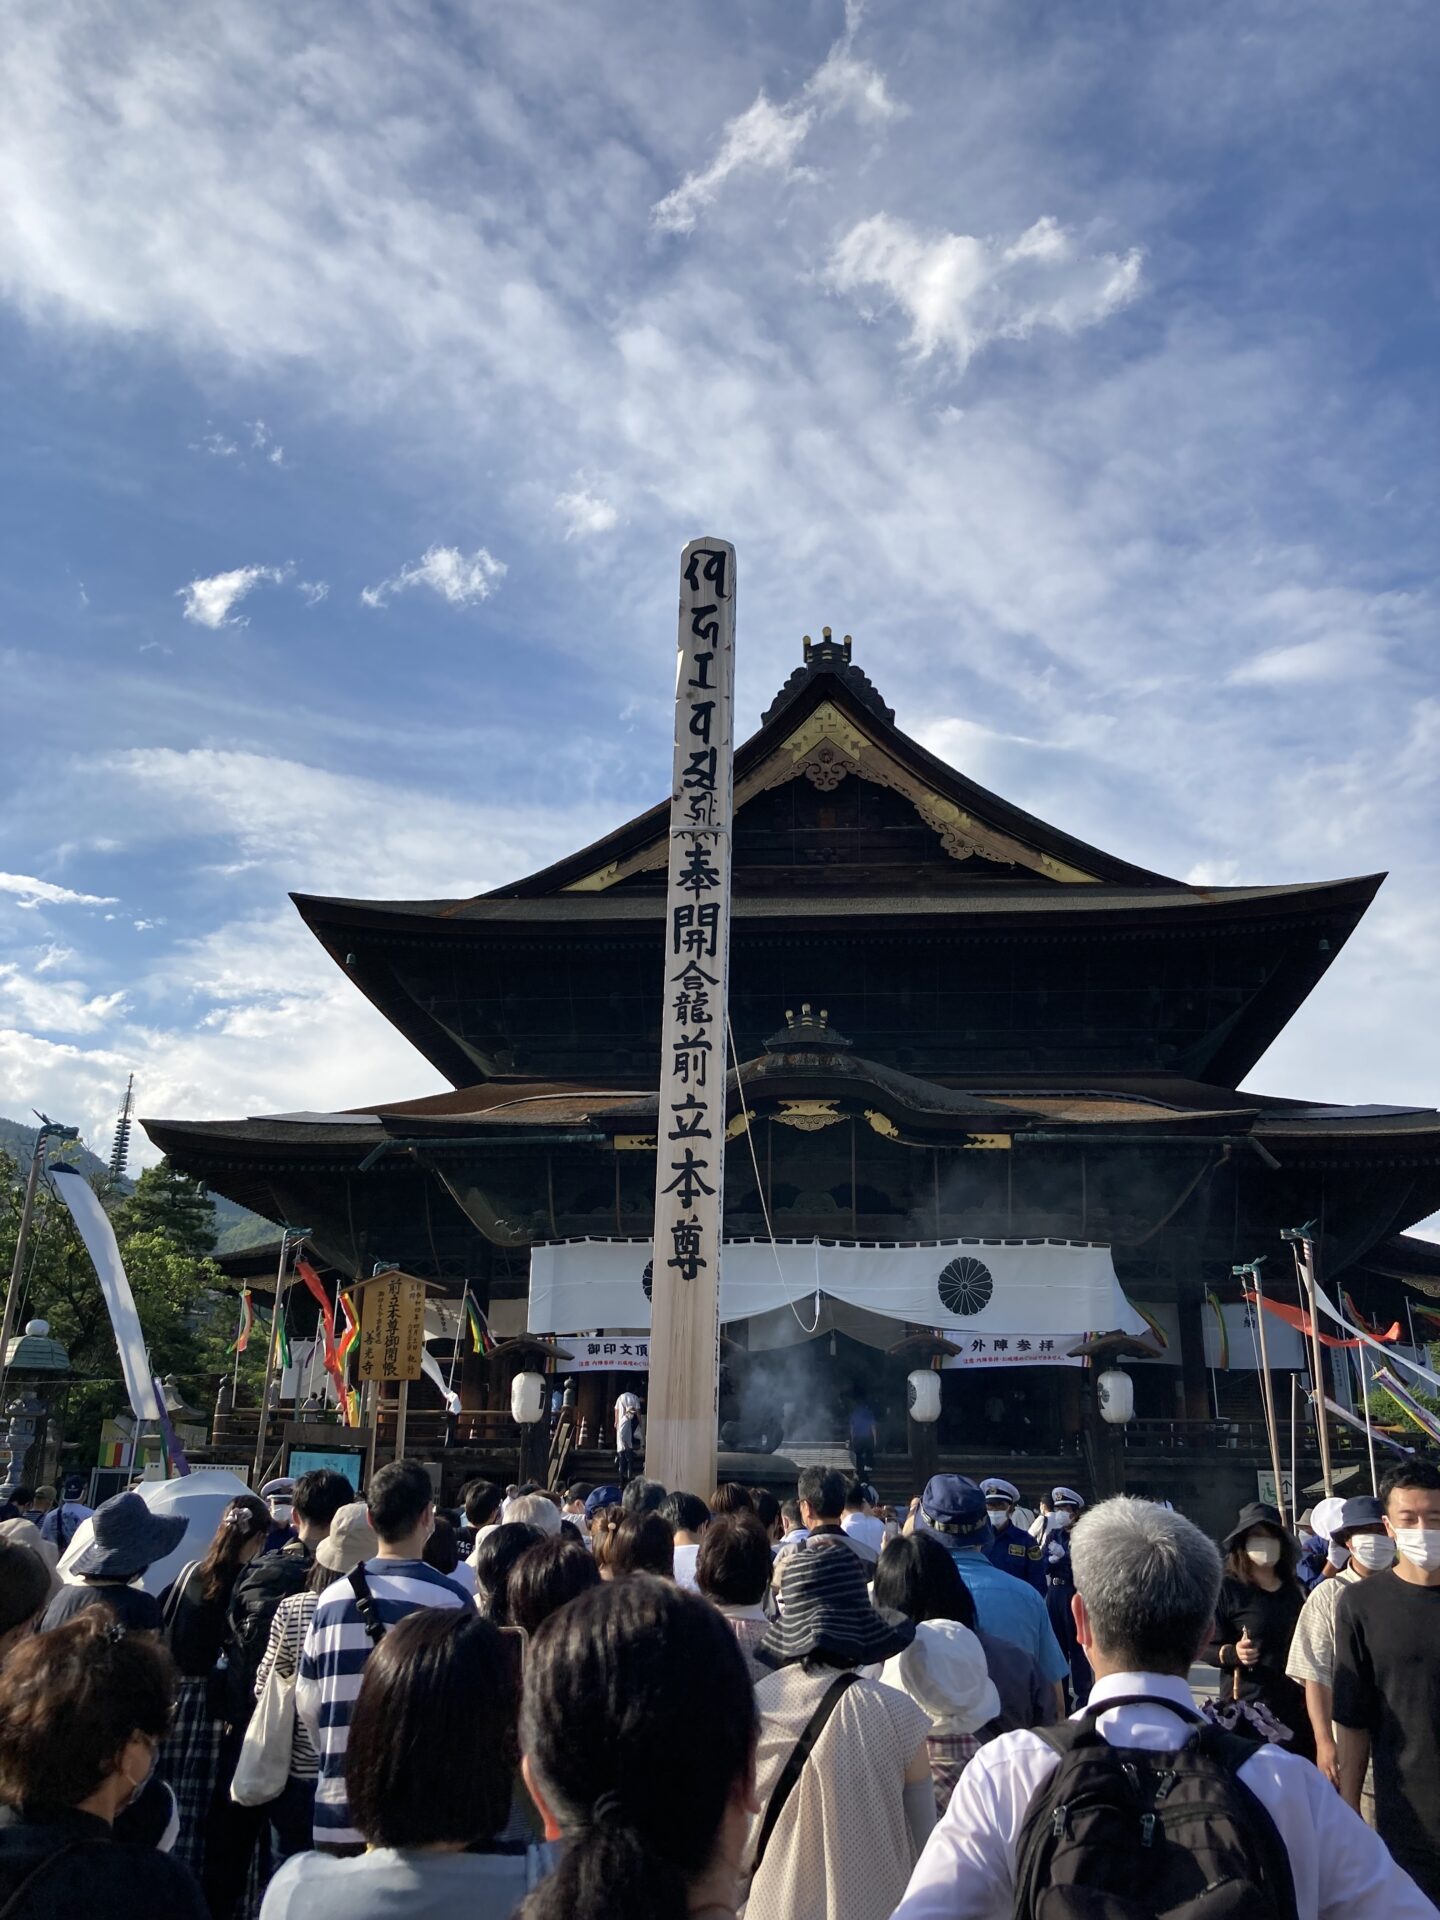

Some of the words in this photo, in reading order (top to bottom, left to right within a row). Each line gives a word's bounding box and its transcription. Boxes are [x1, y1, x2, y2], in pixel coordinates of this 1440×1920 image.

[362, 1330, 375, 1375] 善光寺
[971, 1339, 1055, 1352] 外陣参拝
